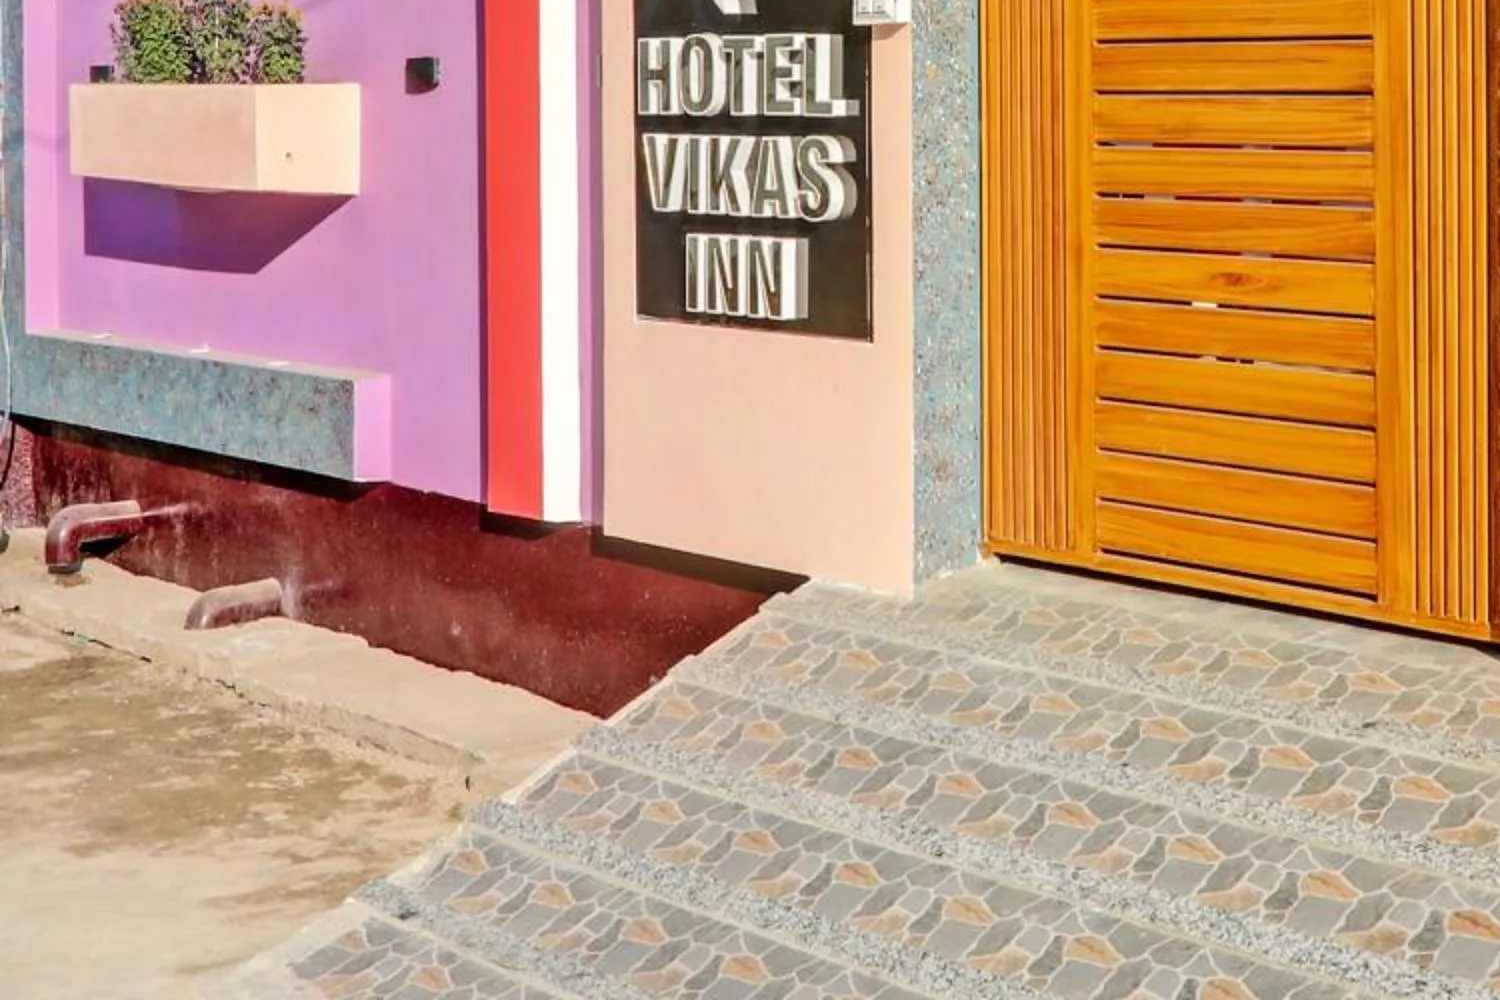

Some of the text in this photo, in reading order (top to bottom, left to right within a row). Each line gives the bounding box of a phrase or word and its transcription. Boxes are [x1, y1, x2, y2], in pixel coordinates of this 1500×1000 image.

[637, 32, 859, 117] HOTEL
[642, 133, 858, 222] VIKAS
[685, 233, 809, 320] INN
